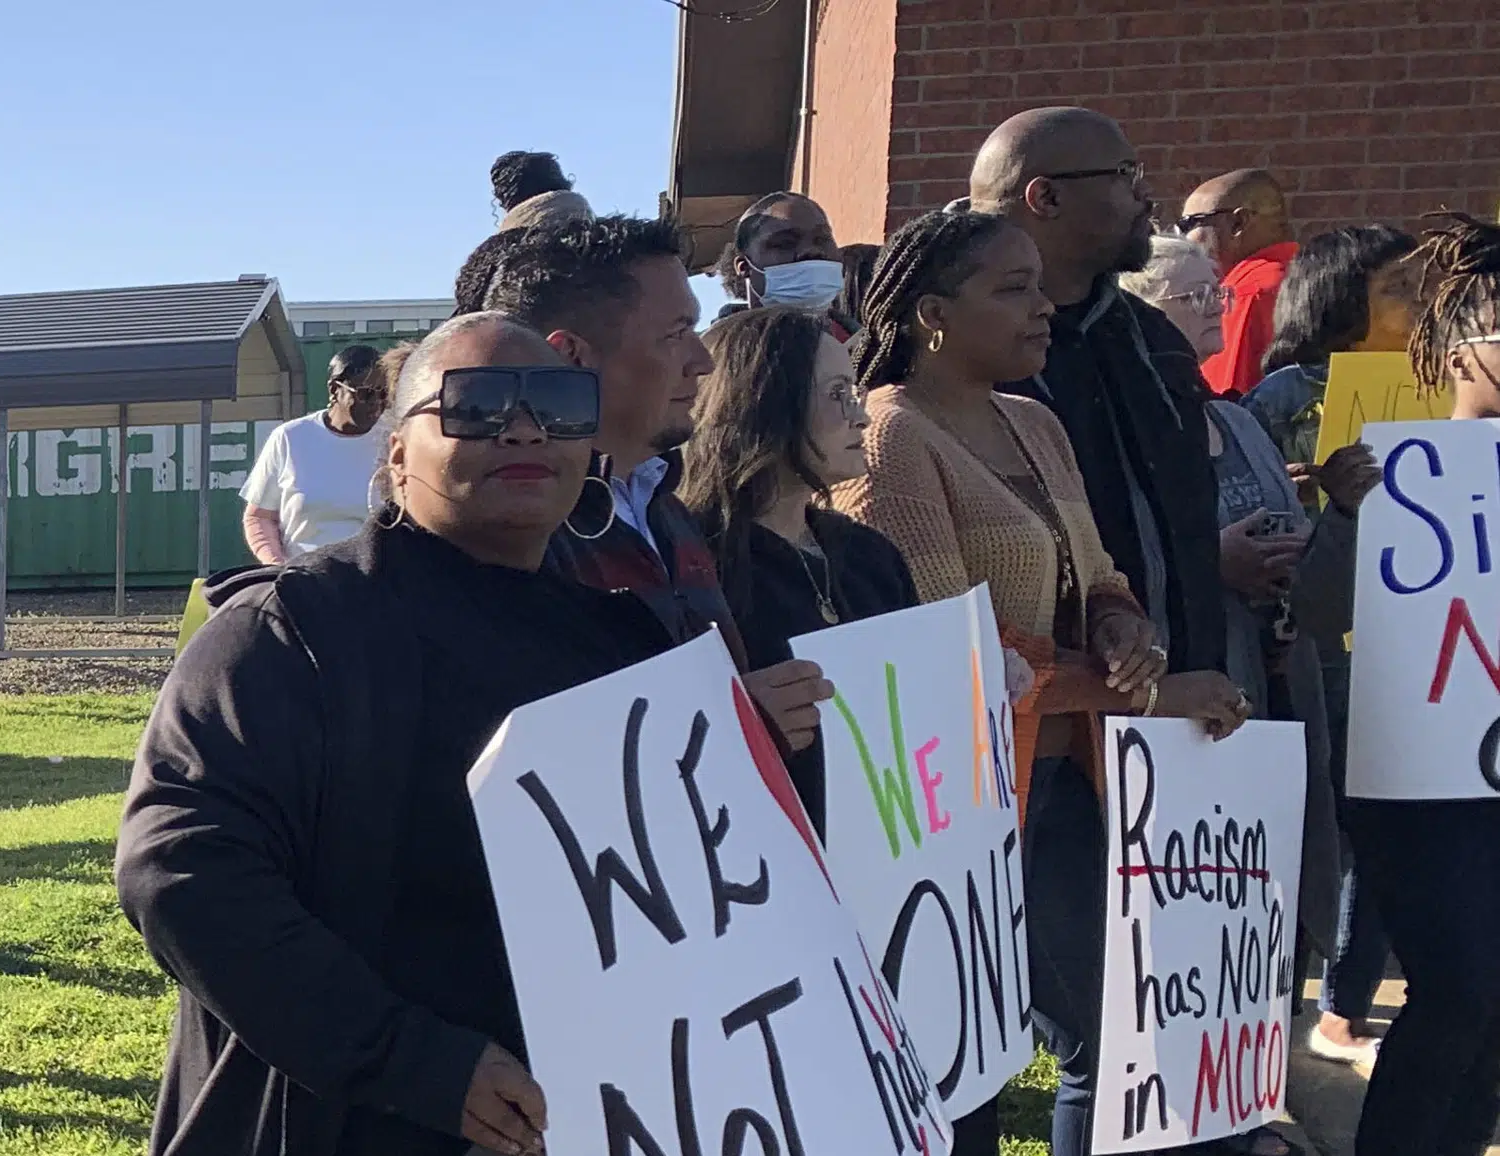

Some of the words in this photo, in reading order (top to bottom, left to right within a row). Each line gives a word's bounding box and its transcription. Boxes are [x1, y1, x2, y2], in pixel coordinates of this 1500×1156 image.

[1380, 438, 1500, 594] Si
[516, 697, 769, 970] WE
[1117, 727, 1269, 917] Racism
[1132, 918, 1206, 1032] has
[1122, 1063, 1168, 1140] in
